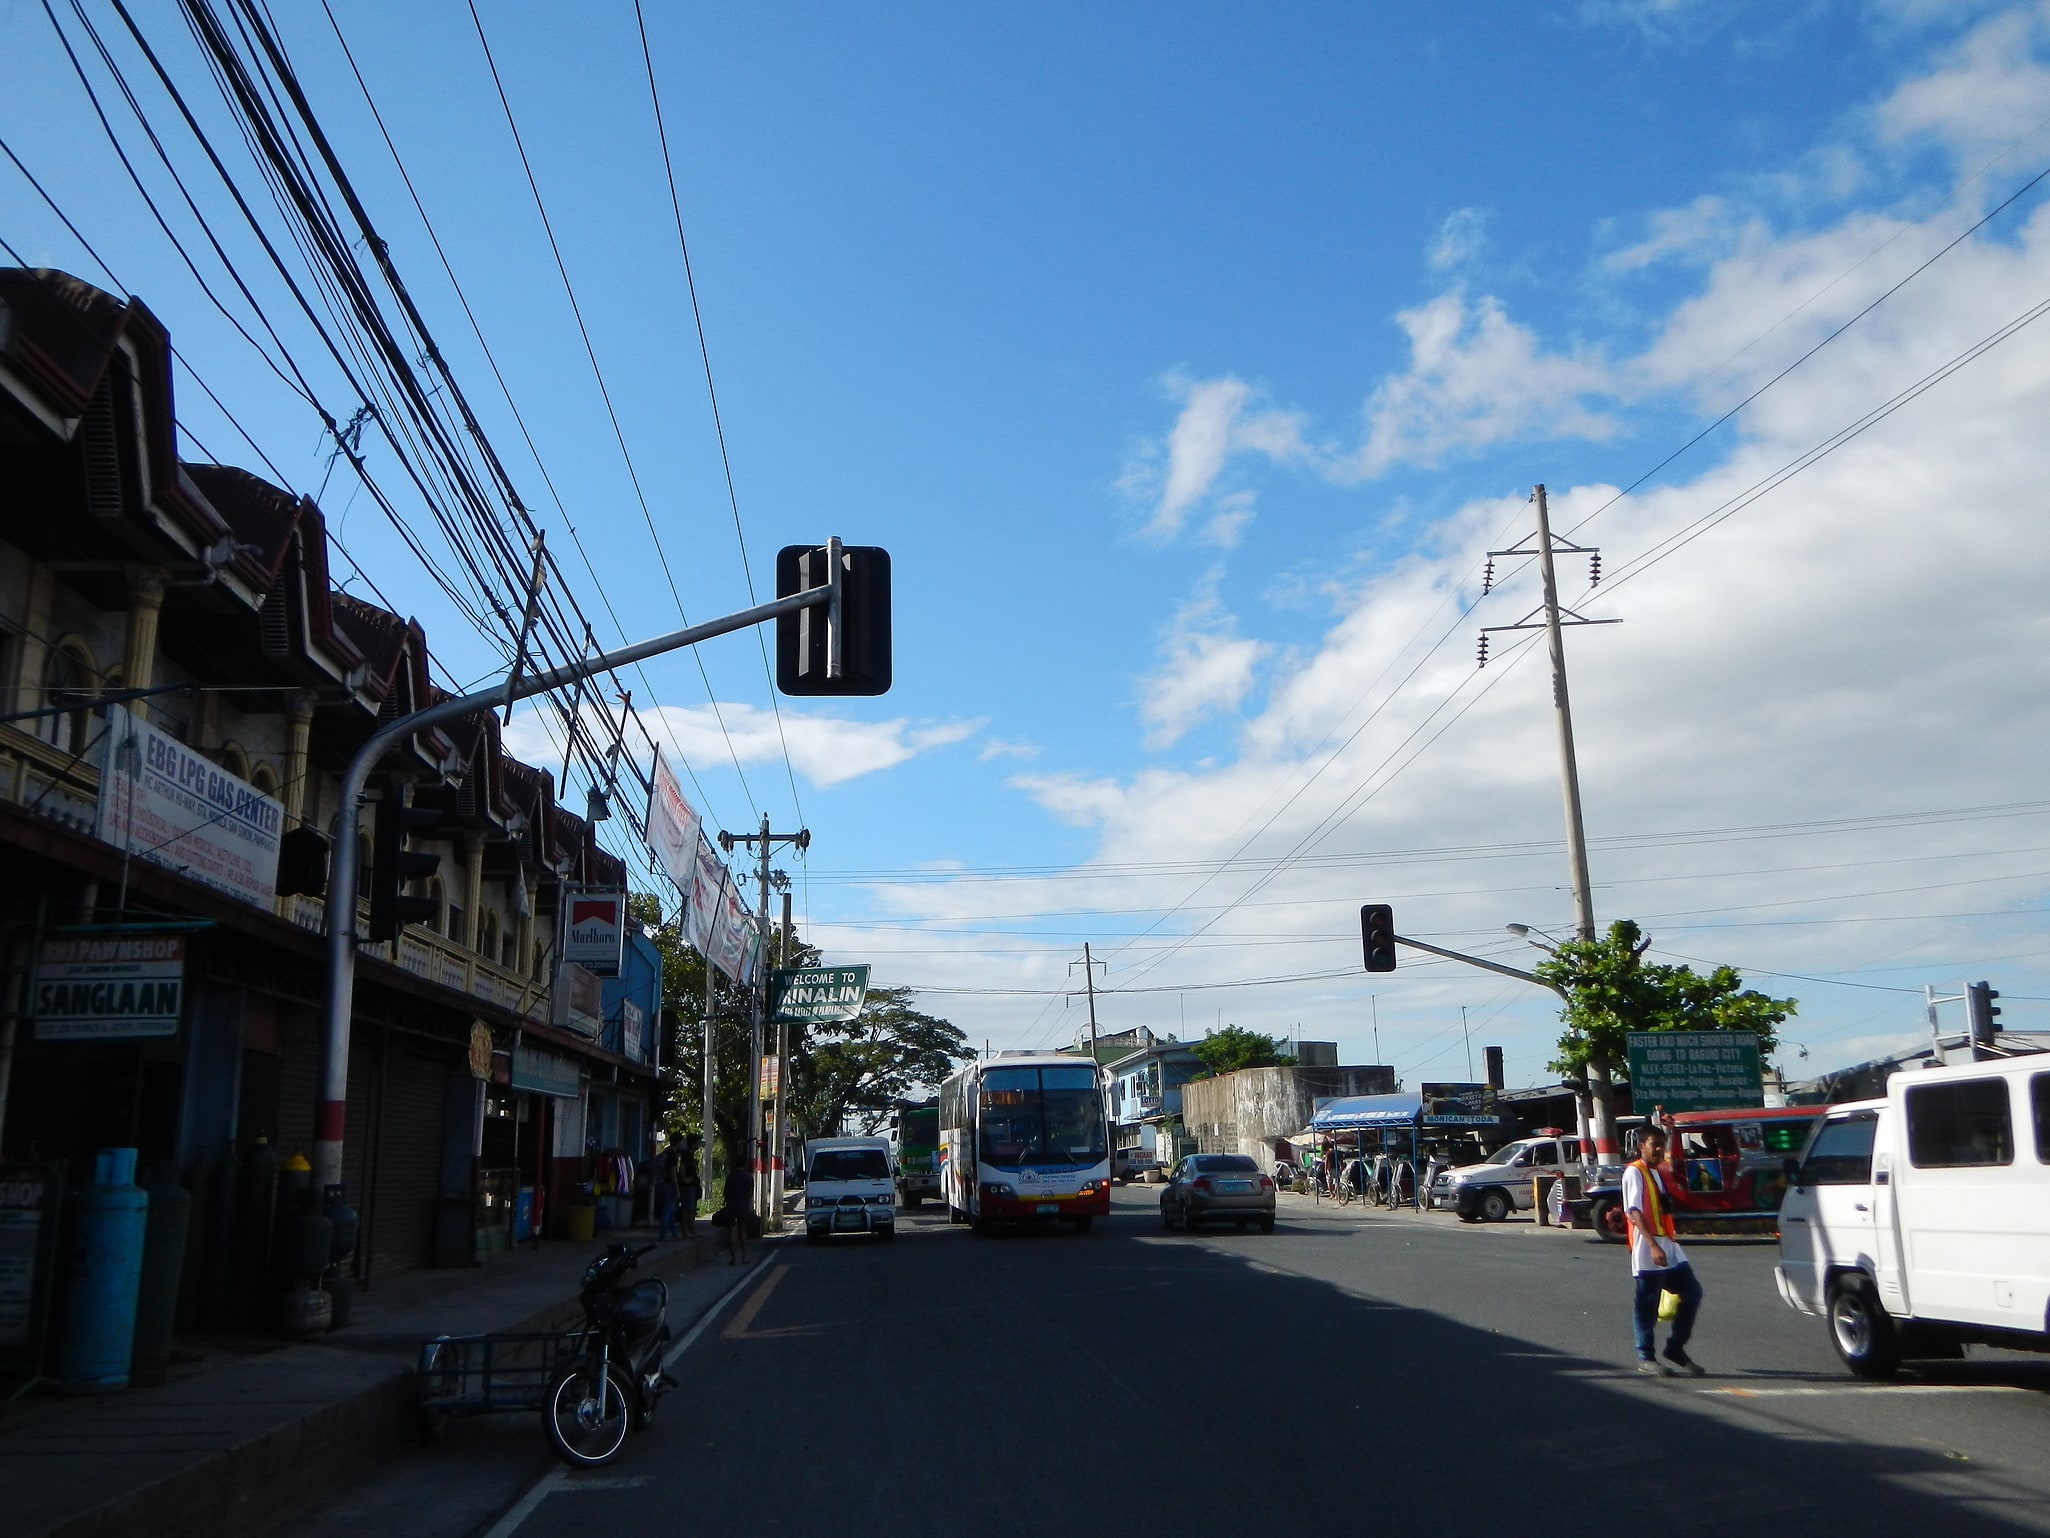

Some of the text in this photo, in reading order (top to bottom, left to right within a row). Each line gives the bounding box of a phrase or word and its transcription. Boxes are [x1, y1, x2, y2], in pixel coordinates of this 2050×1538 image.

[146, 733, 279, 834] EBG LPG GAS CENTER
[572, 927, 615, 944] Marlboro
[78, 940, 178, 960] PAWNSHOP
[784, 973, 855, 985] WELCOME TO
[38, 983, 179, 1016] SANGLAAN
[777, 987, 859, 1005] MINALIN
[1629, 1034, 1755, 1047] FASTER AND MUCH SHORTER ROAD
[1647, 1048, 1741, 1060] GOING TO BAGUIO CITY
[1141, 1096, 1159, 1104] LOTTO
